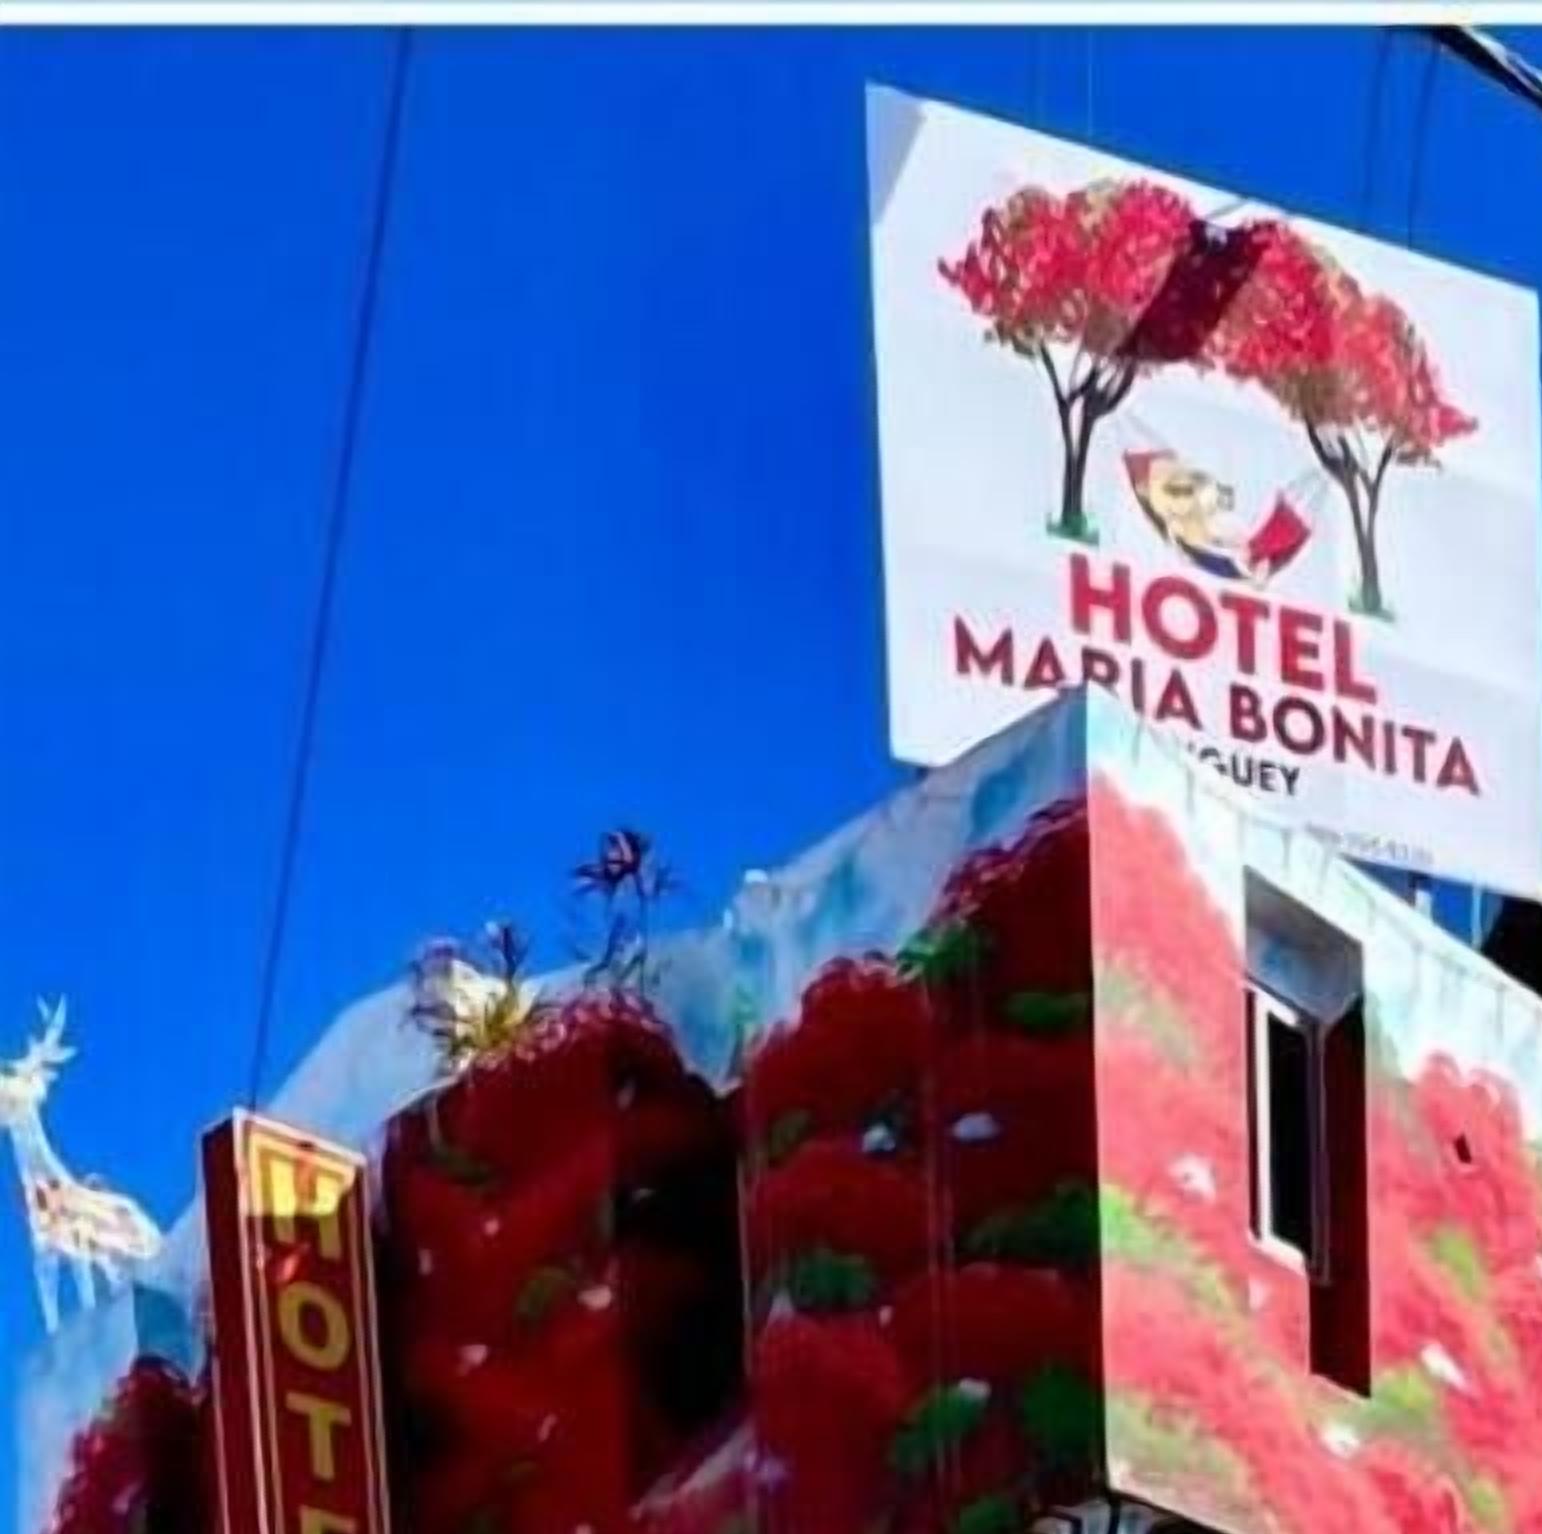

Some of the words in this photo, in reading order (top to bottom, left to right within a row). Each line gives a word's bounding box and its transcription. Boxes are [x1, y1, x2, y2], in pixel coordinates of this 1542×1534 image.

[953, 615, 1203, 731] MARIA
[1229, 683, 1481, 796] BONITA
[1067, 553, 1379, 703] HOTEL
